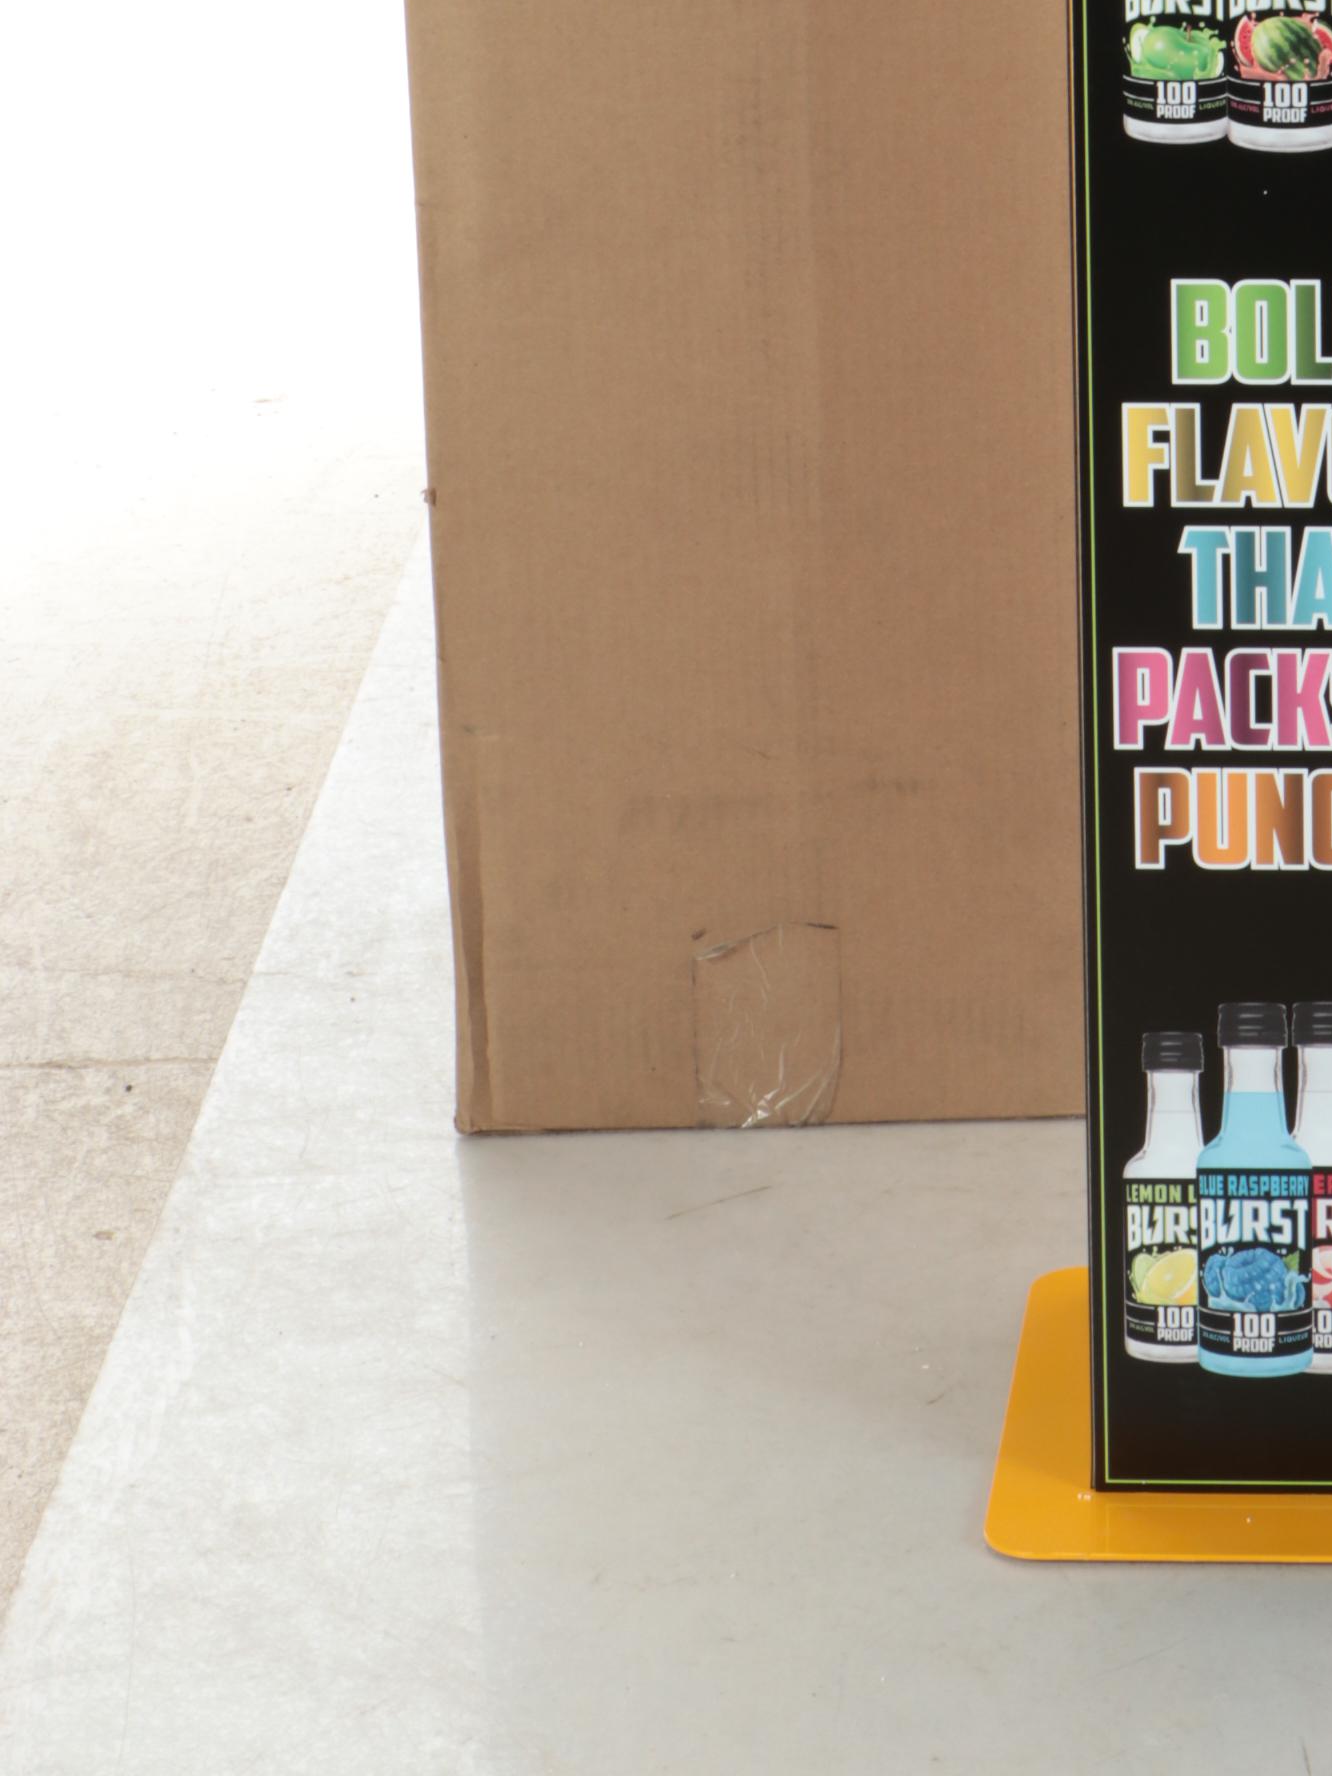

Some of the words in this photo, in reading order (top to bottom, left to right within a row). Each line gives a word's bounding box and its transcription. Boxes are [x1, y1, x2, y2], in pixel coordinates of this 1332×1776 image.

[1156, 81, 1197, 105] 100
[1263, 82, 1308, 107] 100
[1156, 105, 1196, 119] PROOF
[1262, 108, 1308, 123] PROOF
[1126, 1184, 1182, 1203] LEMON
[1199, 1175, 1224, 1196] BLUE
[1227, 1175, 1309, 1196] RASPBERRY
[1127, 1205, 1198, 1252] BUR
[1200, 1199, 1308, 1252] BURST
[1157, 1306, 1194, 1328] 100
[1232, 1313, 1276, 1338] 100
[1157, 1328, 1194, 1342] PROOF
[1232, 1338, 1276, 1353] PROOF
